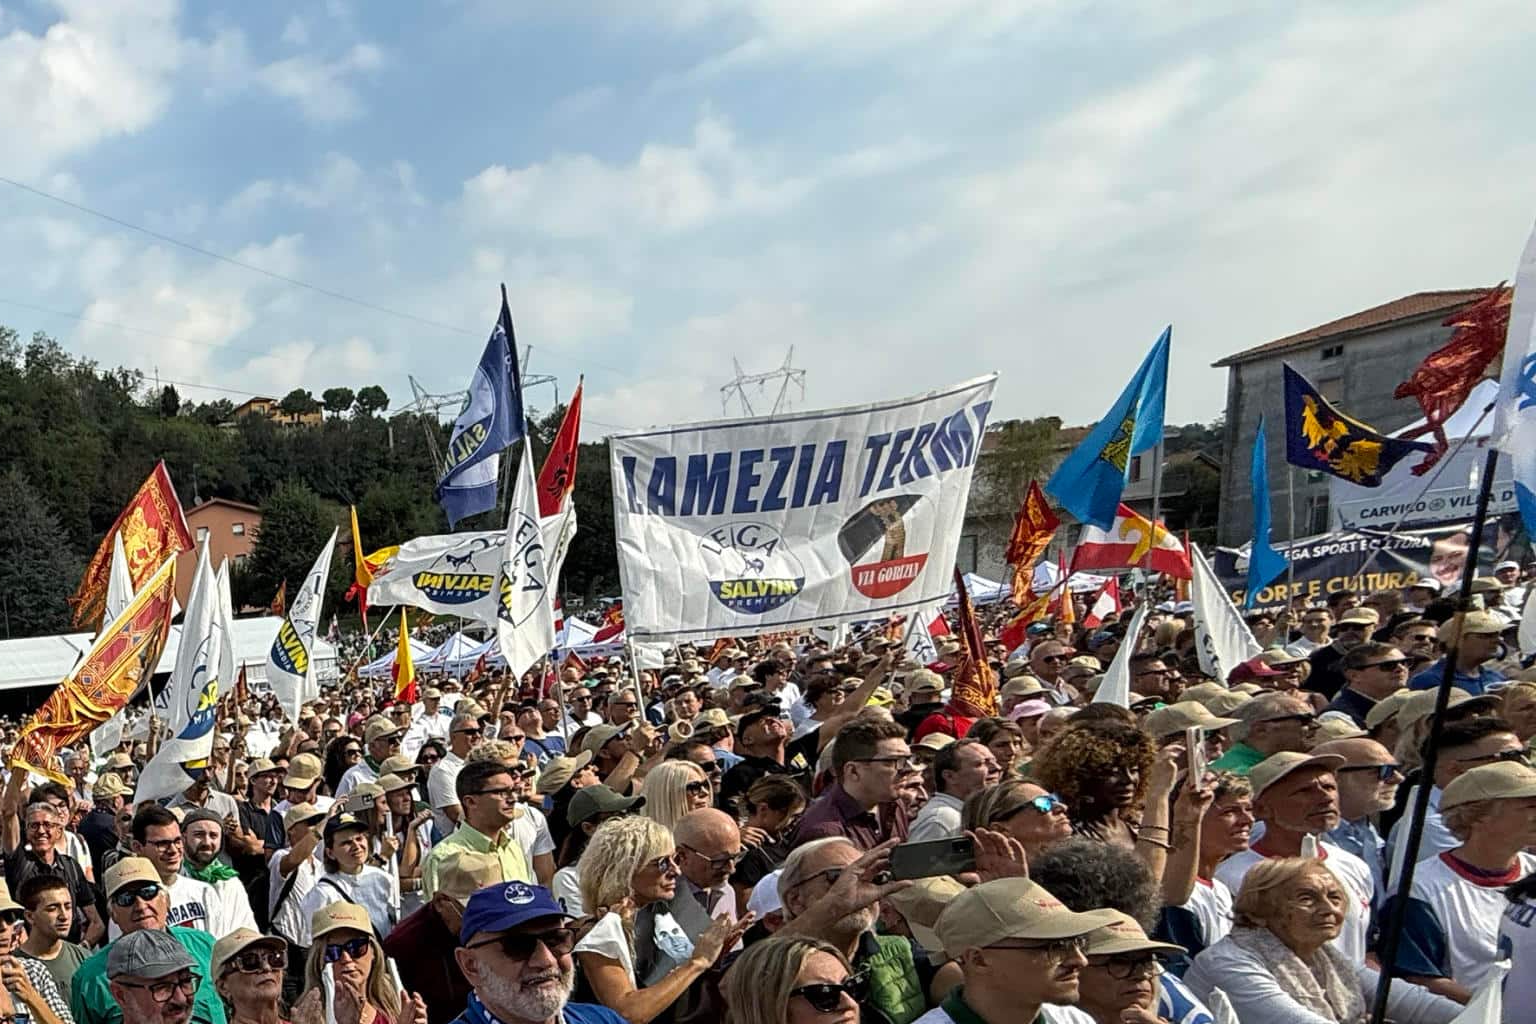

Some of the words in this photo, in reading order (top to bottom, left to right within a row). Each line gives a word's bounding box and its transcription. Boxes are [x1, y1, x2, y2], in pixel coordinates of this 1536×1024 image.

[621, 440, 848, 517] LAMEZIA
[1449, 492, 1496, 508] VILA
[701, 524, 780, 557] LEGA
[1311, 540, 1356, 557] SPORT
[719, 579, 799, 600] SALVINI
[857, 571, 875, 587] VIA
[1230, 581, 1307, 605] SORT
[1309, 578, 1321, 598] E
